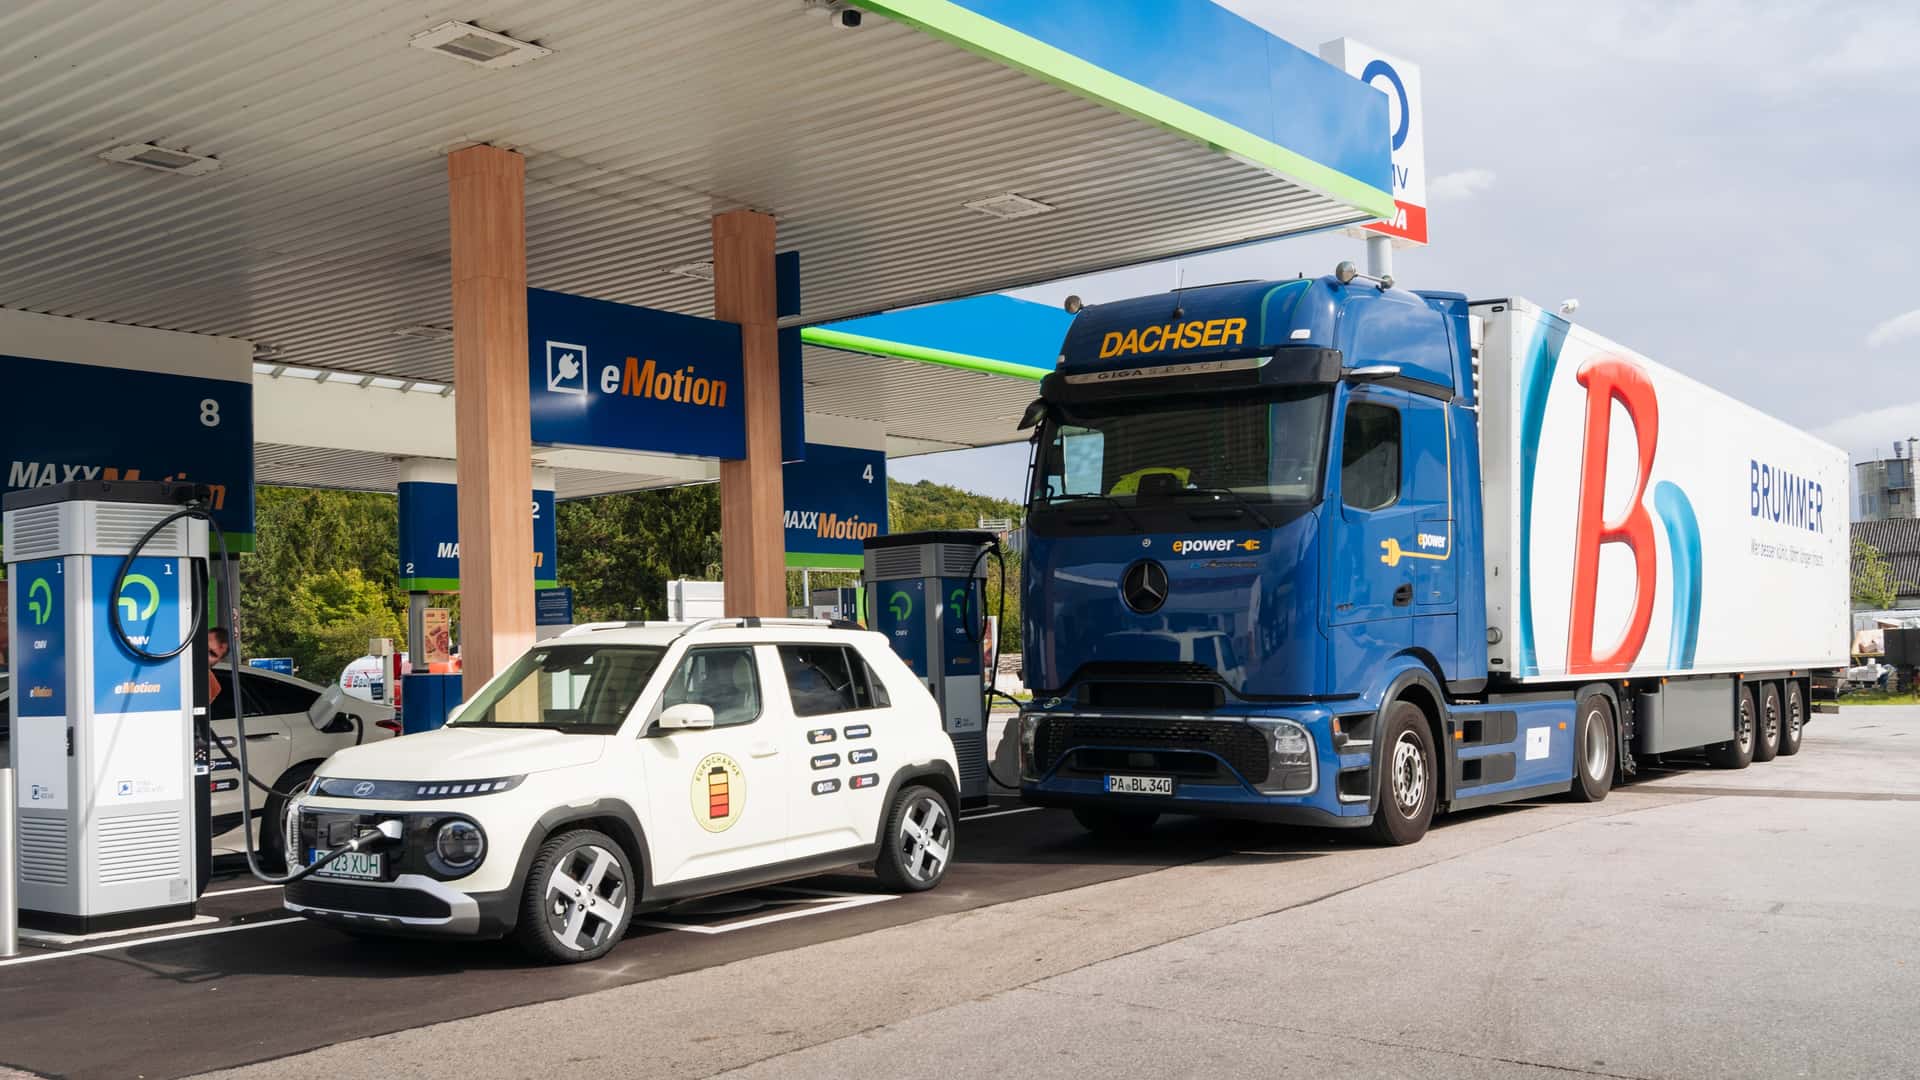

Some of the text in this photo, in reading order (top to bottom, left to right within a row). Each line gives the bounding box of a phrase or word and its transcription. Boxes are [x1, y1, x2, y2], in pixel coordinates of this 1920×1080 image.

[1100, 317, 1247, 358] DACHSER
[600, 356, 727, 408] eMotion
[199, 398, 221, 427] 8
[862, 464, 874, 484] 4
[1750, 459, 1823, 534] BRUMMER
[1172, 538, 1235, 555] epower
[1417, 533, 1446, 549] epower
[56, 562, 62, 574] 1
[164, 564, 173, 575] 1
[406, 562, 415, 574] 2
[114, 682, 161, 695] eMotion
[1110, 777, 1171, 793] PA BL 340
[351, 855, 378, 874] XUH
